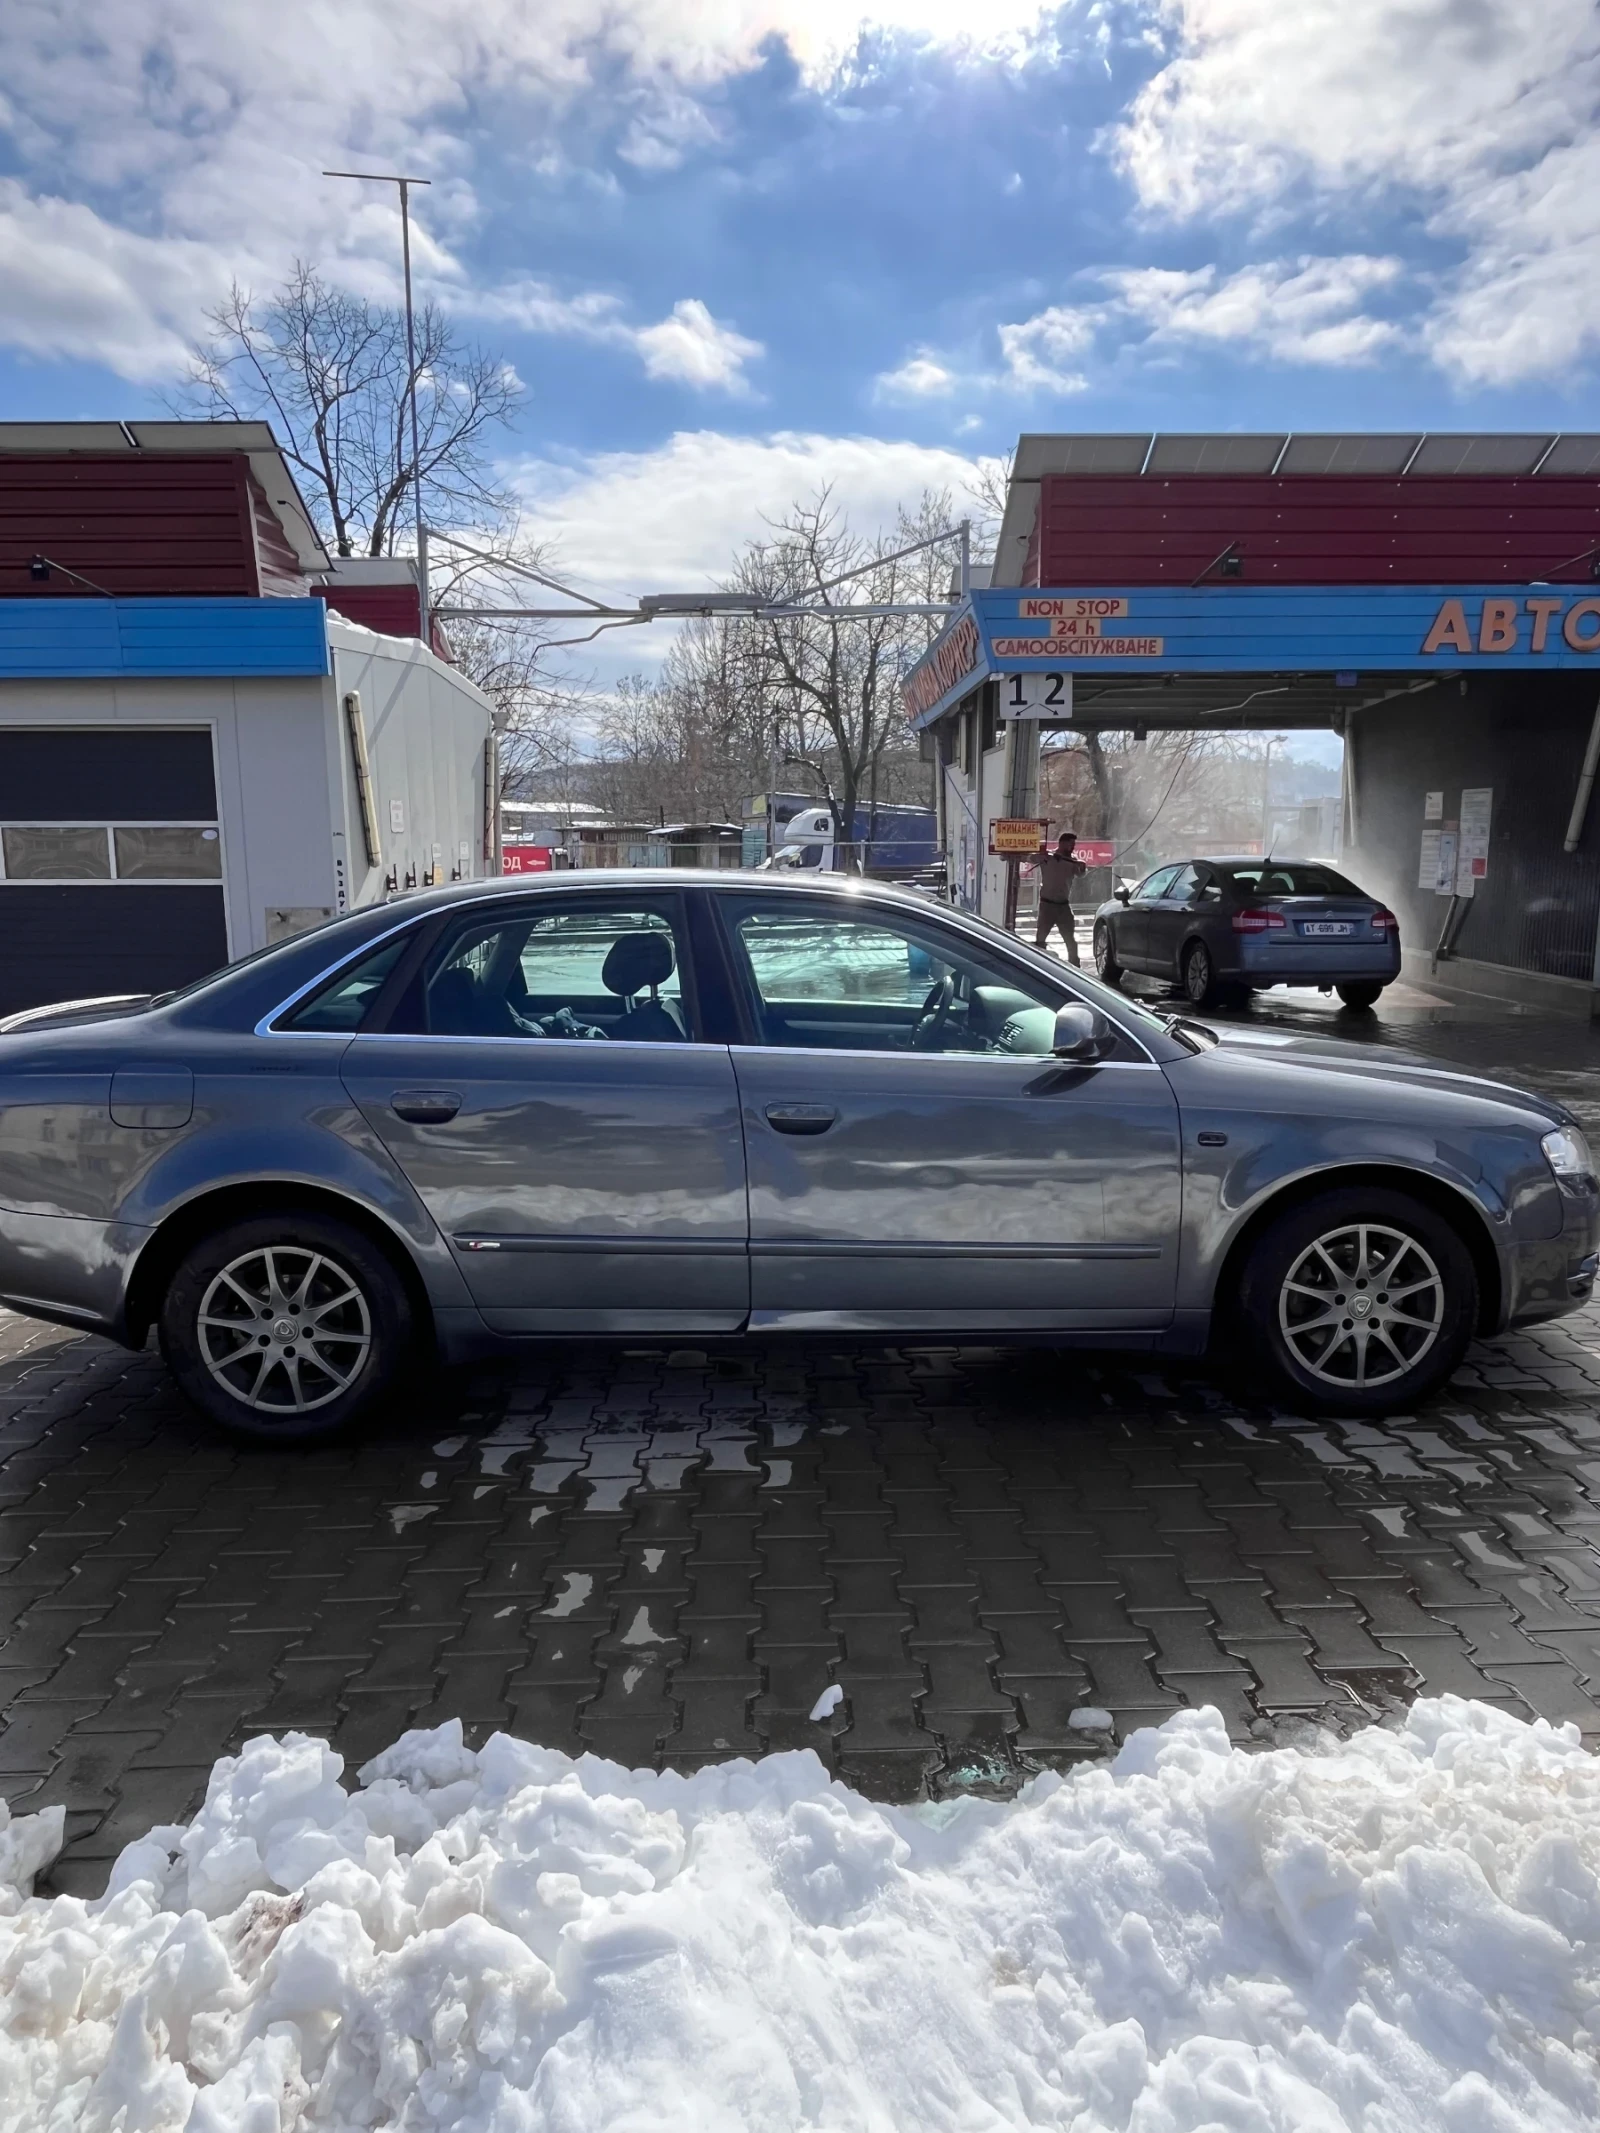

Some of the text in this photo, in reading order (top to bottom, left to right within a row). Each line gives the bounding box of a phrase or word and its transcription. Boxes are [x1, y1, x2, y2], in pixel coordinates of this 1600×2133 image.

[1027, 600, 1120, 616] NON STOP
[1057, 620, 1095, 635] 24 h
[995, 639, 1157, 655] САМООБСЛУЖВАНЕ
[1009, 673, 1065, 706] 1 2
[336, 859, 346, 914] ВЪЗДУ
